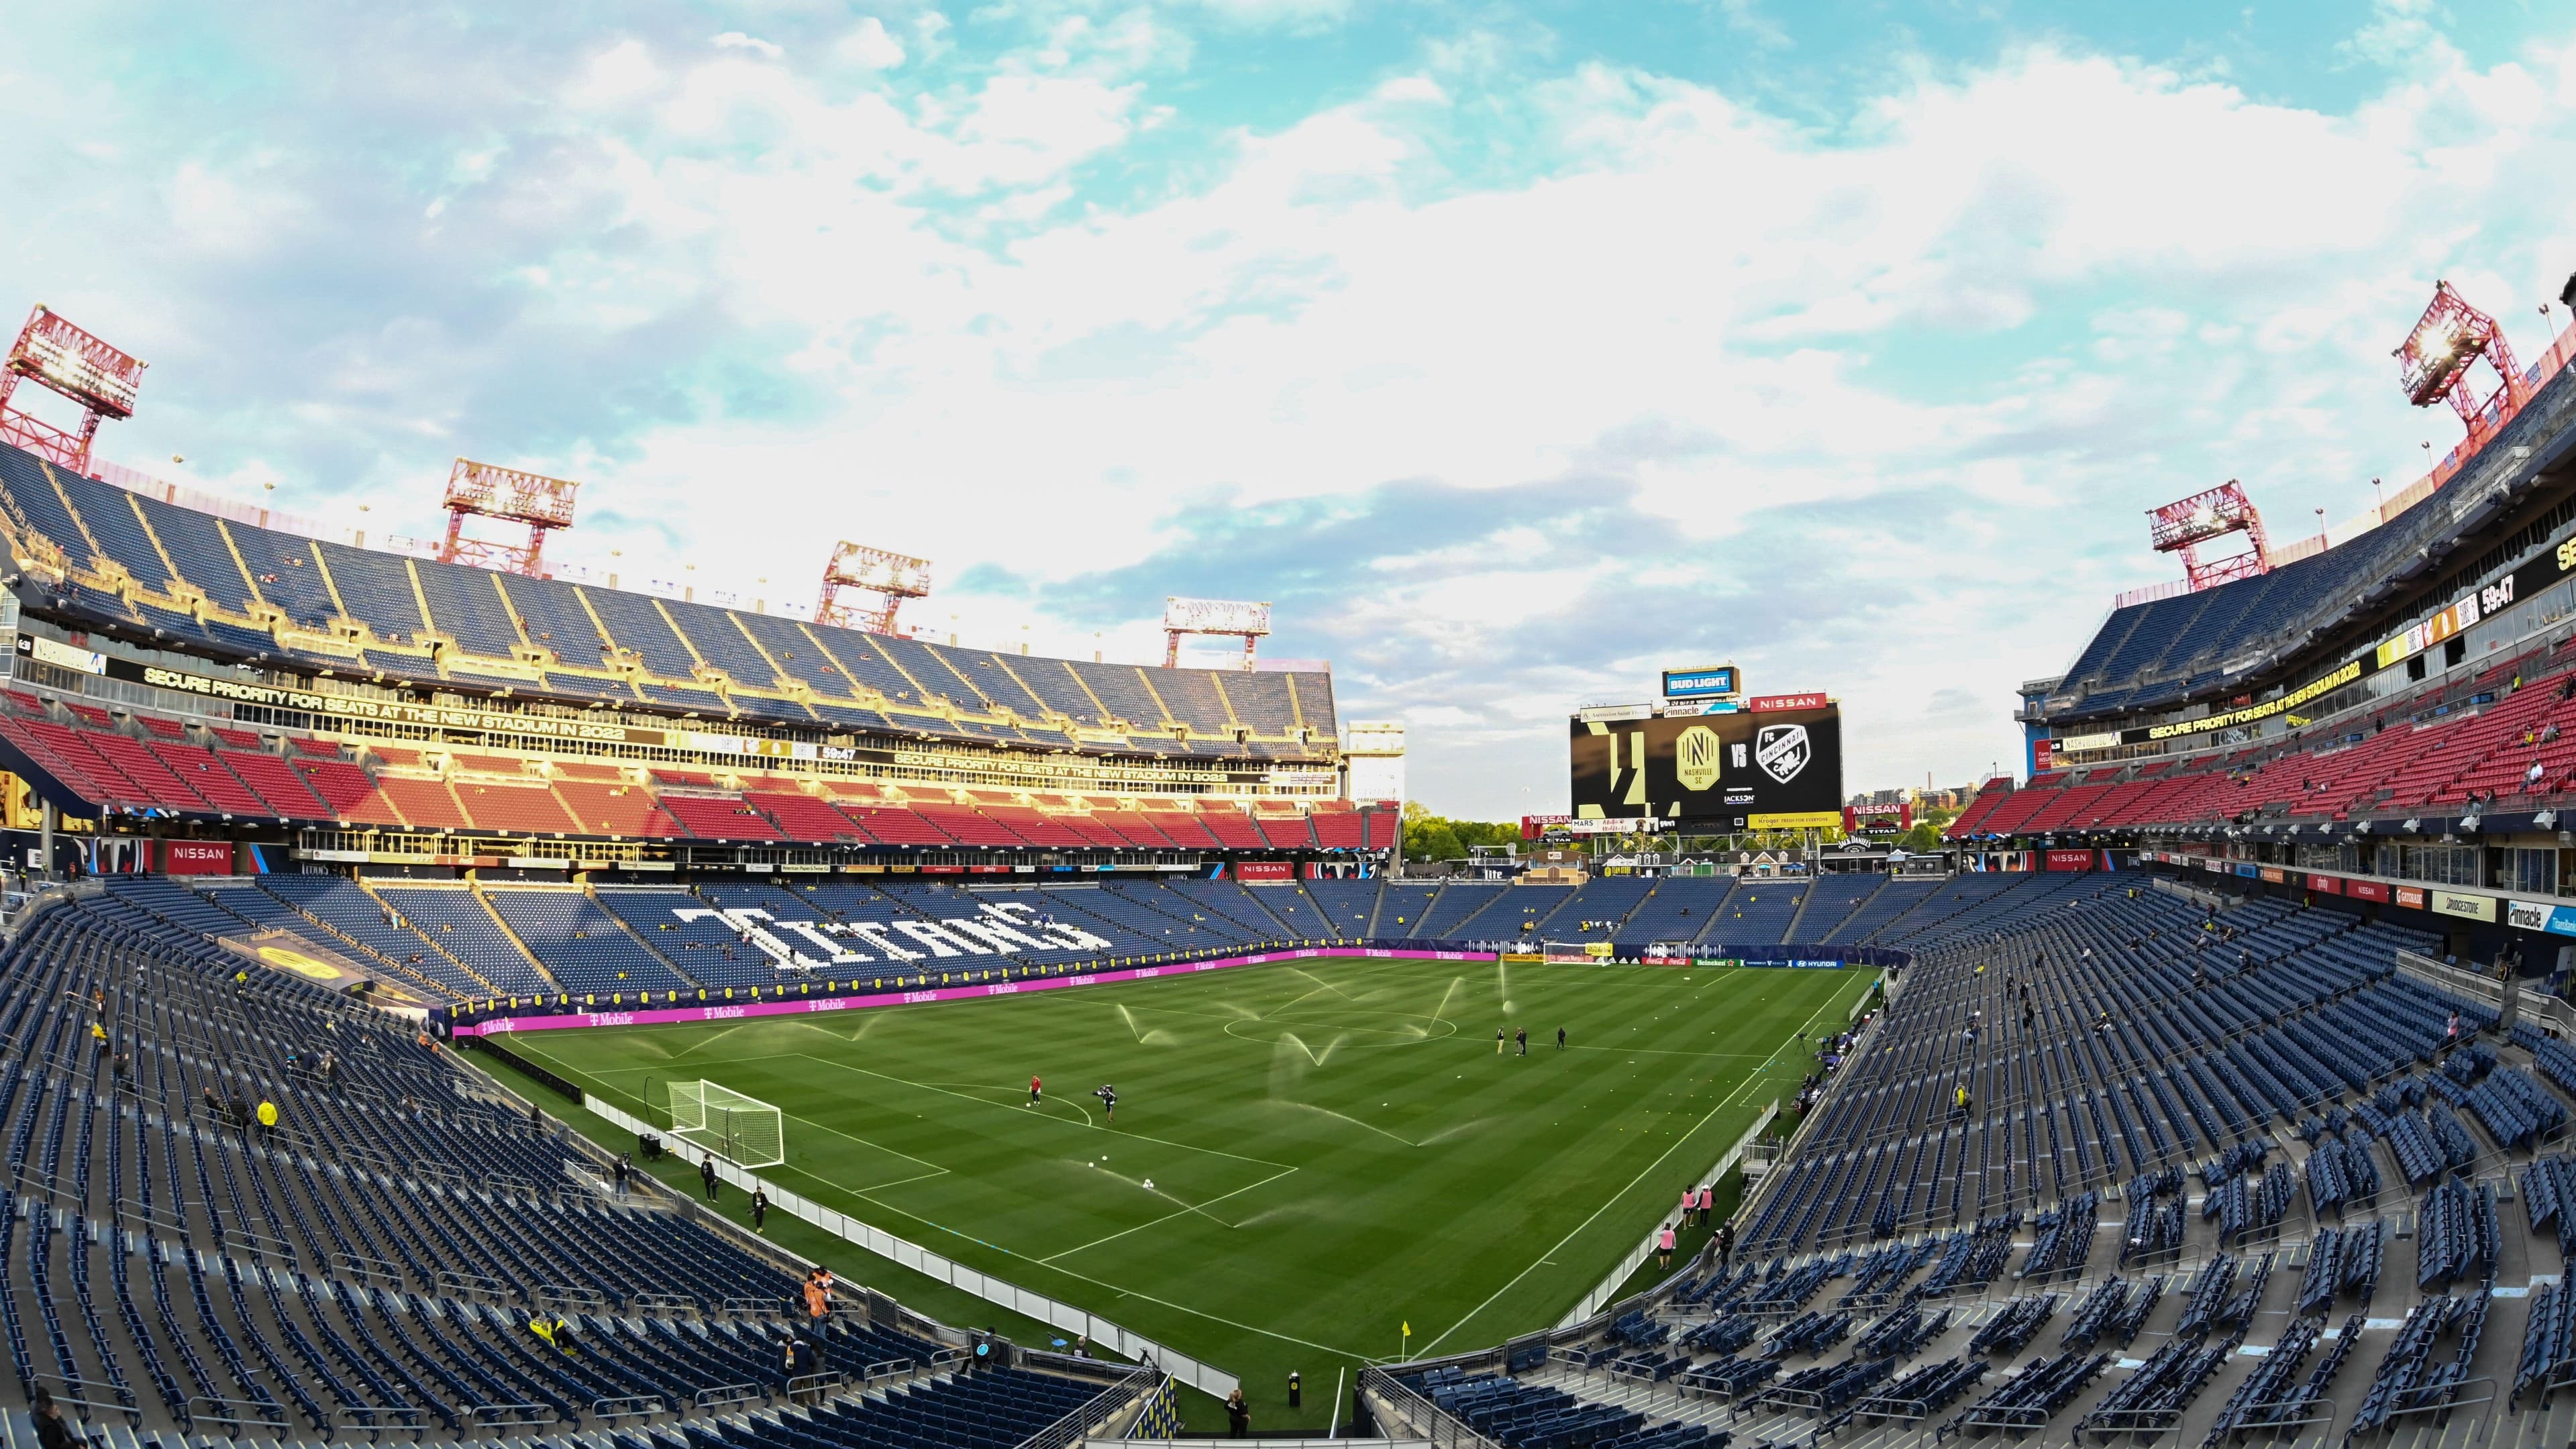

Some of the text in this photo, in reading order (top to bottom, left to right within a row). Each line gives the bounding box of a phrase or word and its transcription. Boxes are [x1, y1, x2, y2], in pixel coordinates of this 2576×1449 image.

[2482, 574, 2514, 614] 59:47
[1670, 676, 1727, 690] BUD LIGHT
[144, 667, 625, 741] SECURE PRIORITY FOR SEATS AT THE NEW STADIUM IN 2022
[1760, 697, 1816, 708] NISSAN
[2149, 659, 2361, 739] SECURE PRIORITY FOR SEATS AT THE NEW STADIUM IN 2022
[1765, 732, 1775, 743] FC
[2066, 737, 2098, 749] NASHVILLE
[2099, 735, 2106, 746] SC
[1761, 729, 1803, 763] CINCINNATI
[1731, 743, 1746, 767] VS
[894, 753, 1228, 782] SECURE PRIORITY FOR SEATS AT THE NEW STADIUM IN 2022
[1695, 776, 1702, 784] SC
[1853, 805, 1900, 815] NISSAN
[1529, 816, 1572, 824] NISSAN
[1759, 815, 1779, 826] Kroger
[1837, 835, 1871, 849] JACK DANIEL'S
[174, 847, 224, 859] NISSAN
[2127, 855, 2140, 867] TITANS
[2358, 885, 2375, 896] NISSAN
[2401, 892, 2422, 905] GATORADE
[2446, 896, 2479, 914] BRIDGESTONE
[2510, 903, 2541, 928] Pinnacle
[672, 902, 1113, 970] TITANS
[1372, 949, 1392, 957] Mobile
[1442, 951, 1463, 960] Mobile
[1141, 968, 1159, 977] Mobile
[1076, 975, 1096, 984] Mobile
[995, 983, 1019, 994] Mobile
[912, 991, 936, 1002] Mobile
[818, 1000, 845, 1010] Mobile
[600, 1011, 633, 1025] Mobile
[714, 1006, 745, 1018] Mobile
[487, 1018, 515, 1033] Mobile
